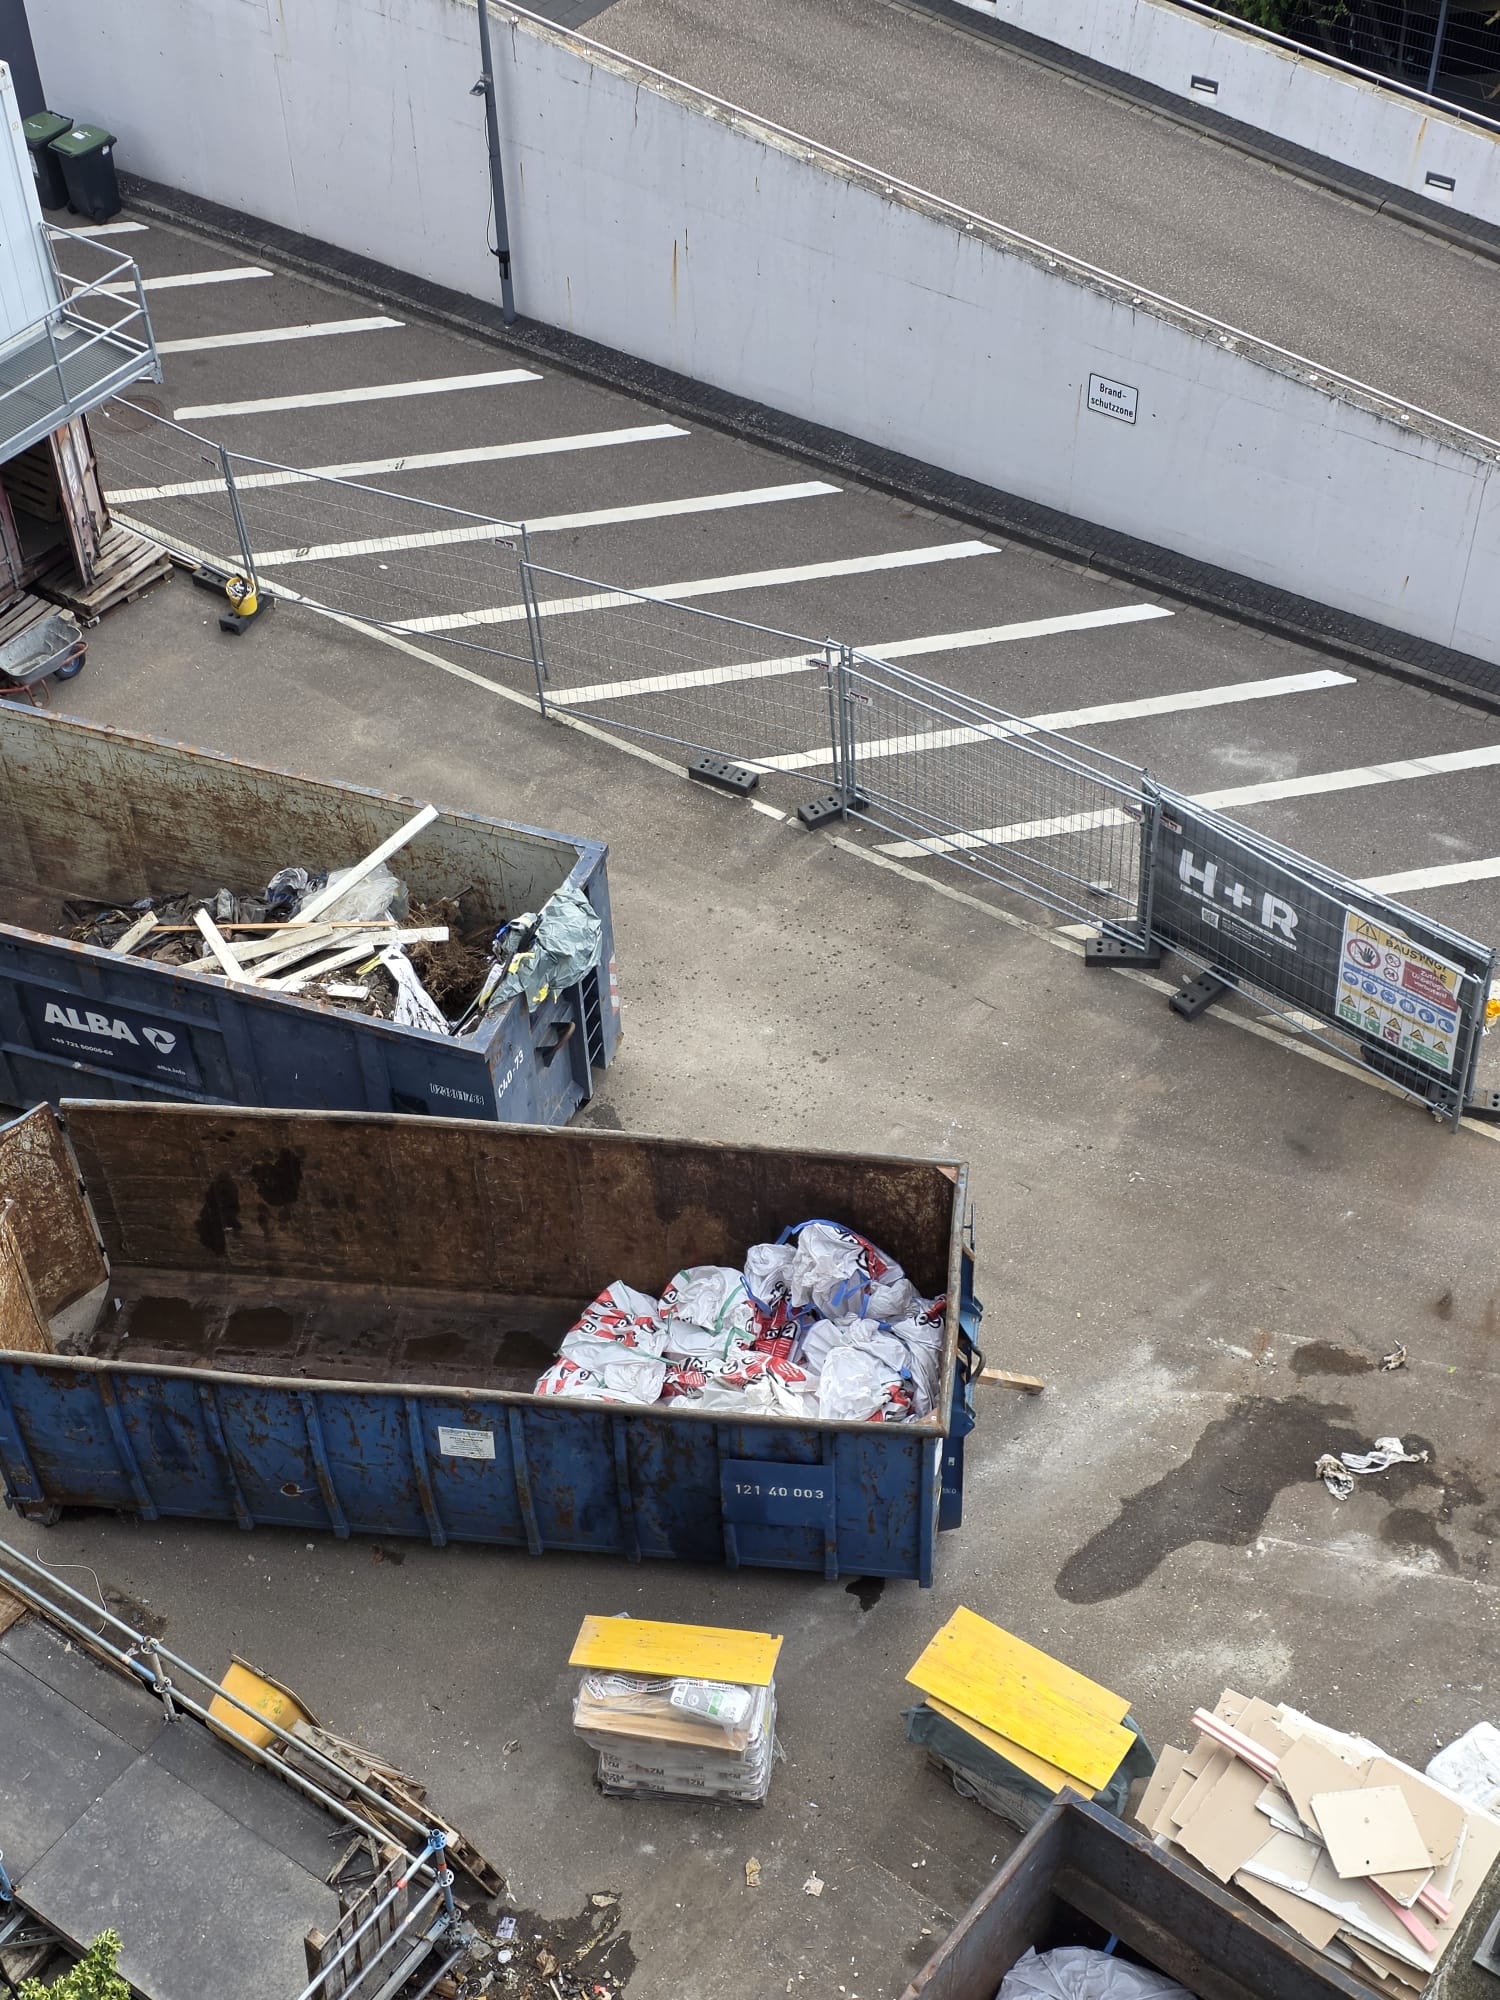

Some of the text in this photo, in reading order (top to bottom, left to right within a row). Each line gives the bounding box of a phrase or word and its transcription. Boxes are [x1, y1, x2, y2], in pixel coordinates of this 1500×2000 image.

[1099, 382, 1127, 399] Brand-
[1090, 396, 1134, 418] schutzzone
[1179, 848, 1298, 941] H+R
[44, 1002, 140, 1046] ALBA
[735, 1483, 824, 1499] 121 40 003
